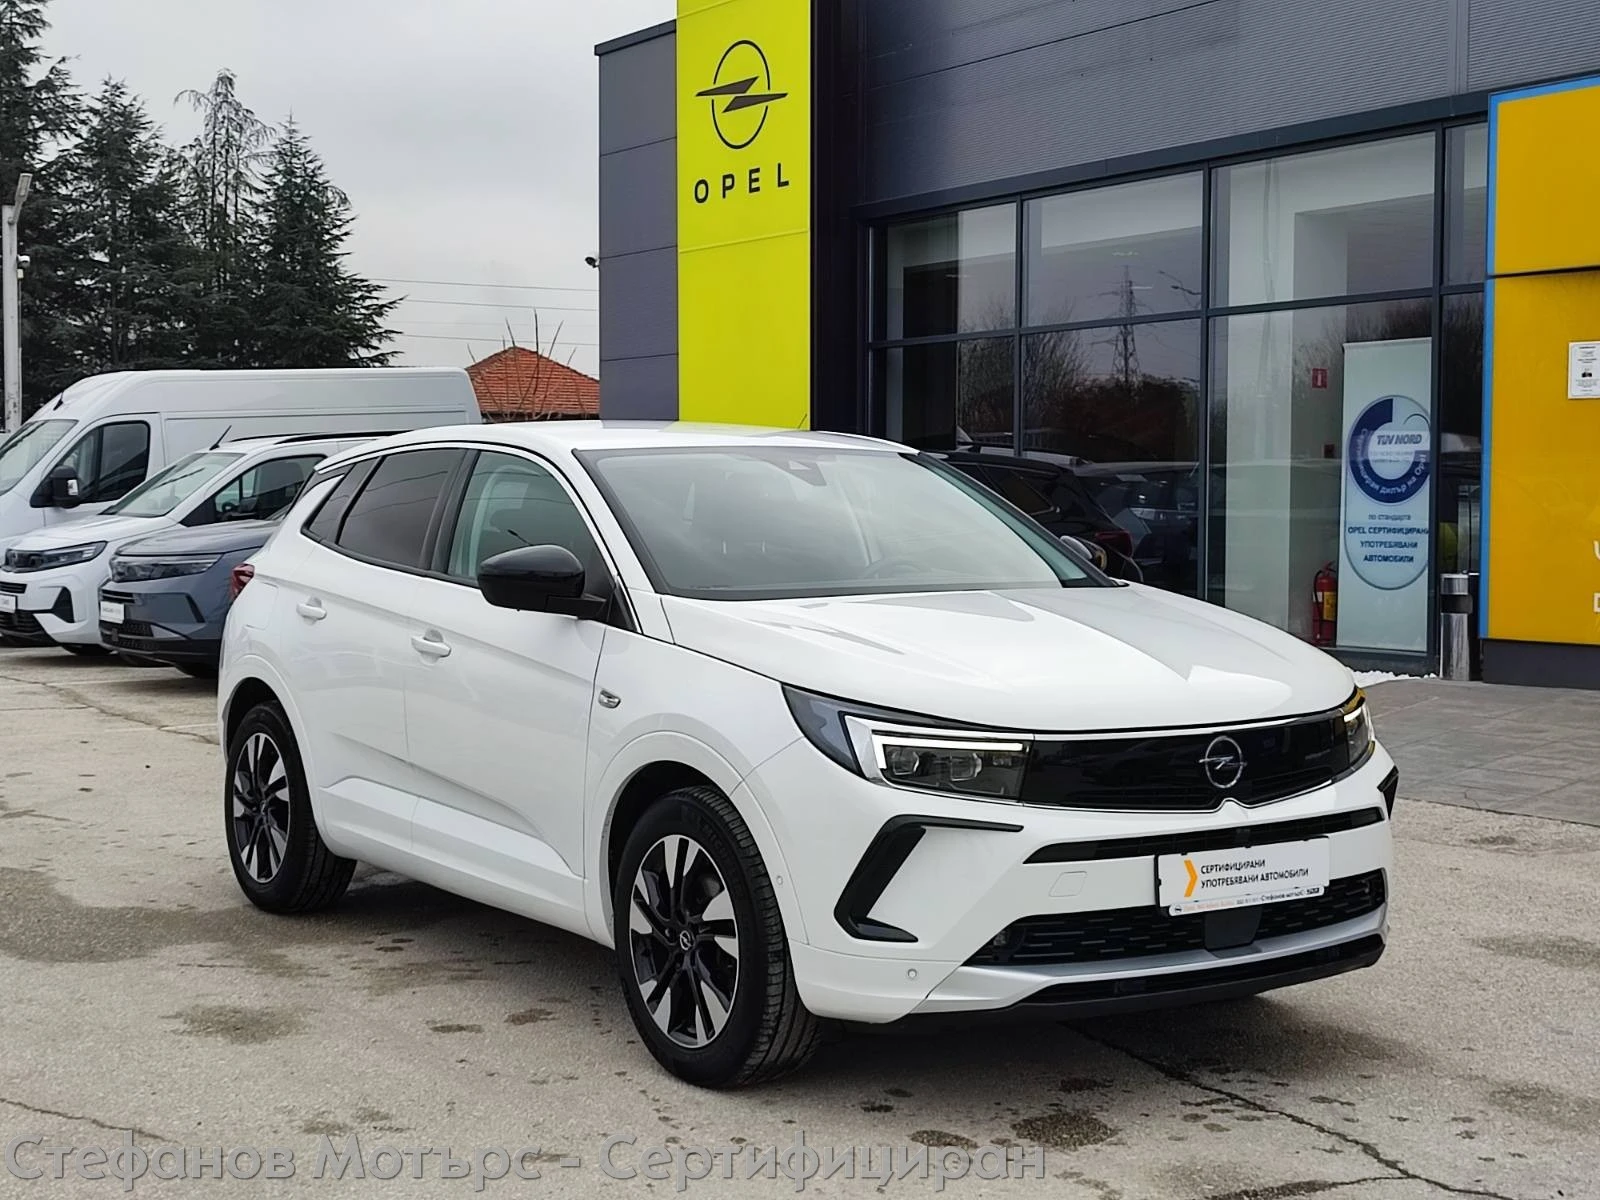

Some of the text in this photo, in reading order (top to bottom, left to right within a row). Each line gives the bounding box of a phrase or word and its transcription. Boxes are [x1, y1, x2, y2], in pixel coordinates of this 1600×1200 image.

[694, 162, 790, 204] OPEL
[1395, 434, 1423, 445] NORD
[1348, 526, 1366, 534] OPEL
[1363, 554, 1414, 562] АВТОМОБИЛИ
[1200, 859, 1266, 875] СЕРТИФИЦИРАНИ
[1201, 868, 1309, 889] УПОТРЕБЯВАНИ АВТОМОБИЛИ
